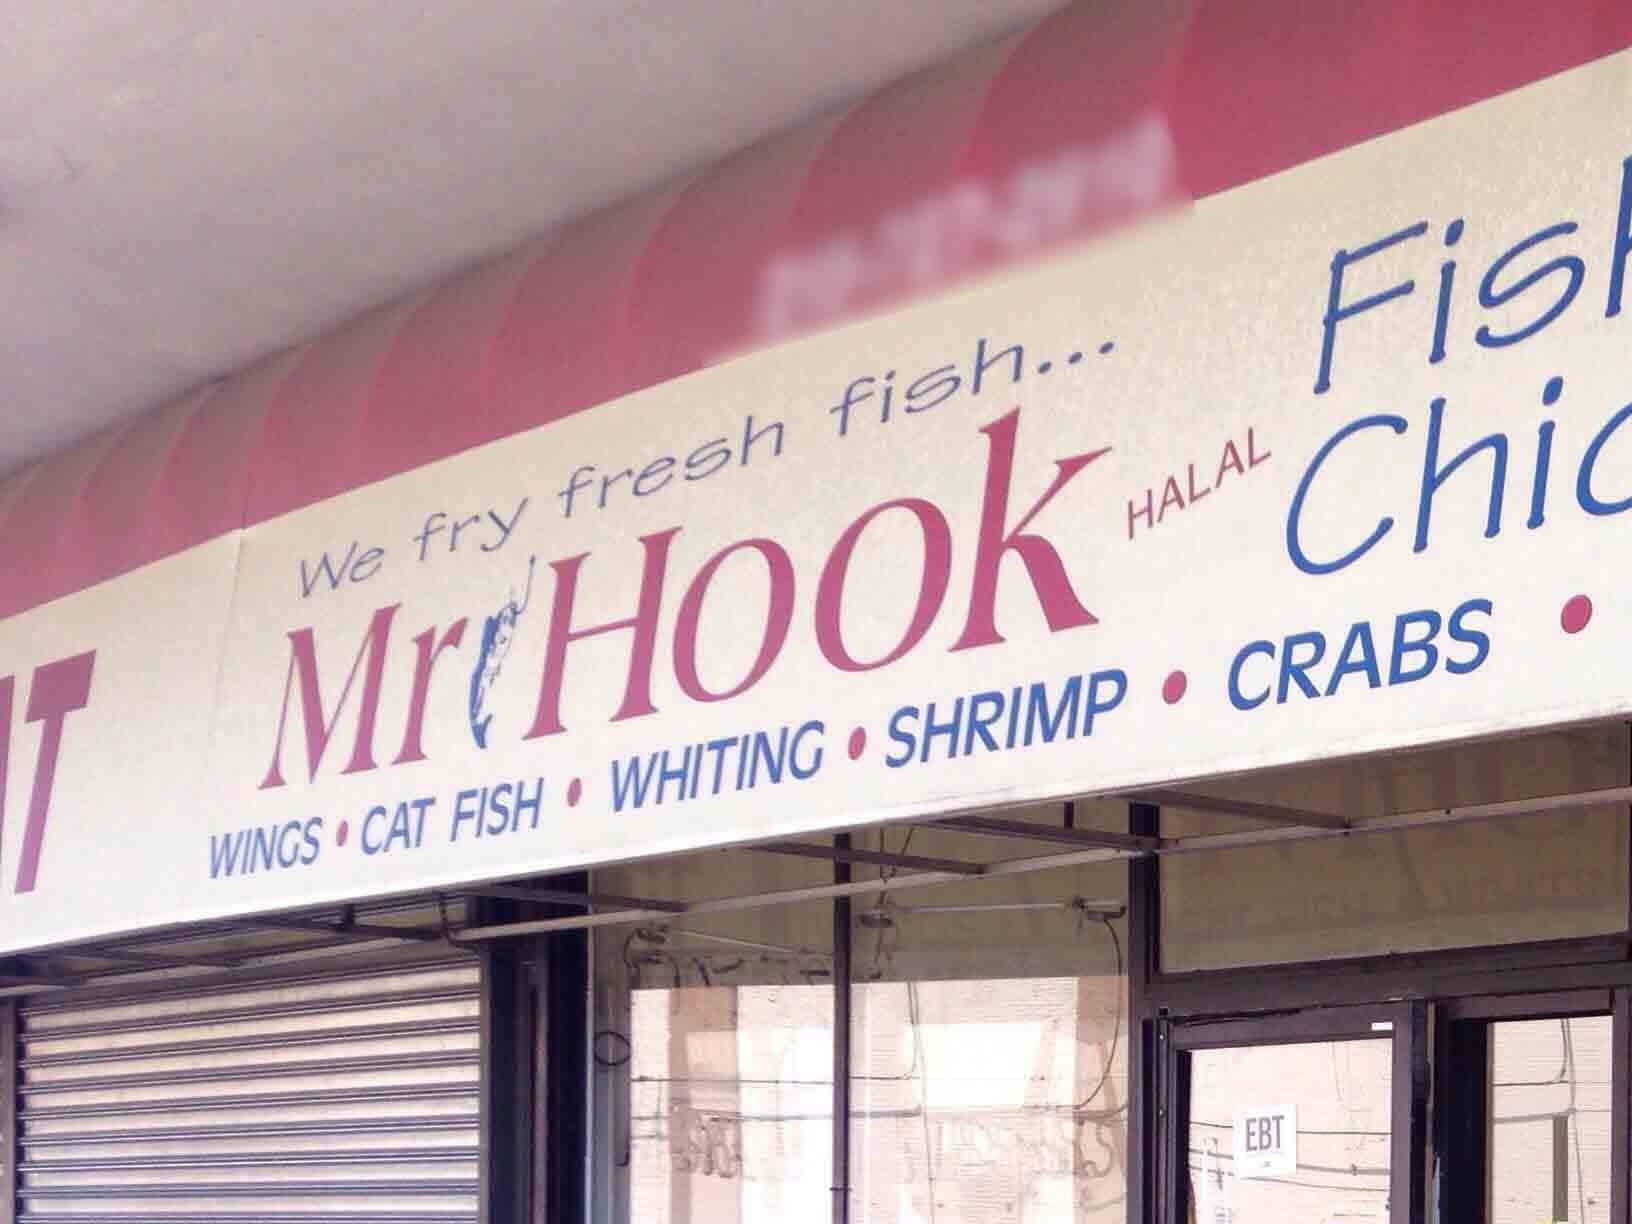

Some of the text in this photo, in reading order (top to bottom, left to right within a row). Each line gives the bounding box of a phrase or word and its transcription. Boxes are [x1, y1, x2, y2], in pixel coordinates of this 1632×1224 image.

[298, 336, 1115, 598] We fry fresh fish...
[1125, 427, 1272, 539] HALAL
[258, 408, 1112, 789] Mr Hook
[208, 817, 321, 879] WINGS
[361, 799, 437, 855] CAT
[448, 778, 544, 844] FISH
[609, 721, 825, 811] WHITING
[885, 668, 1127, 769] SHRIMP
[1226, 598, 1493, 710] CRABS
[1245, 1115, 1285, 1152] EBT
